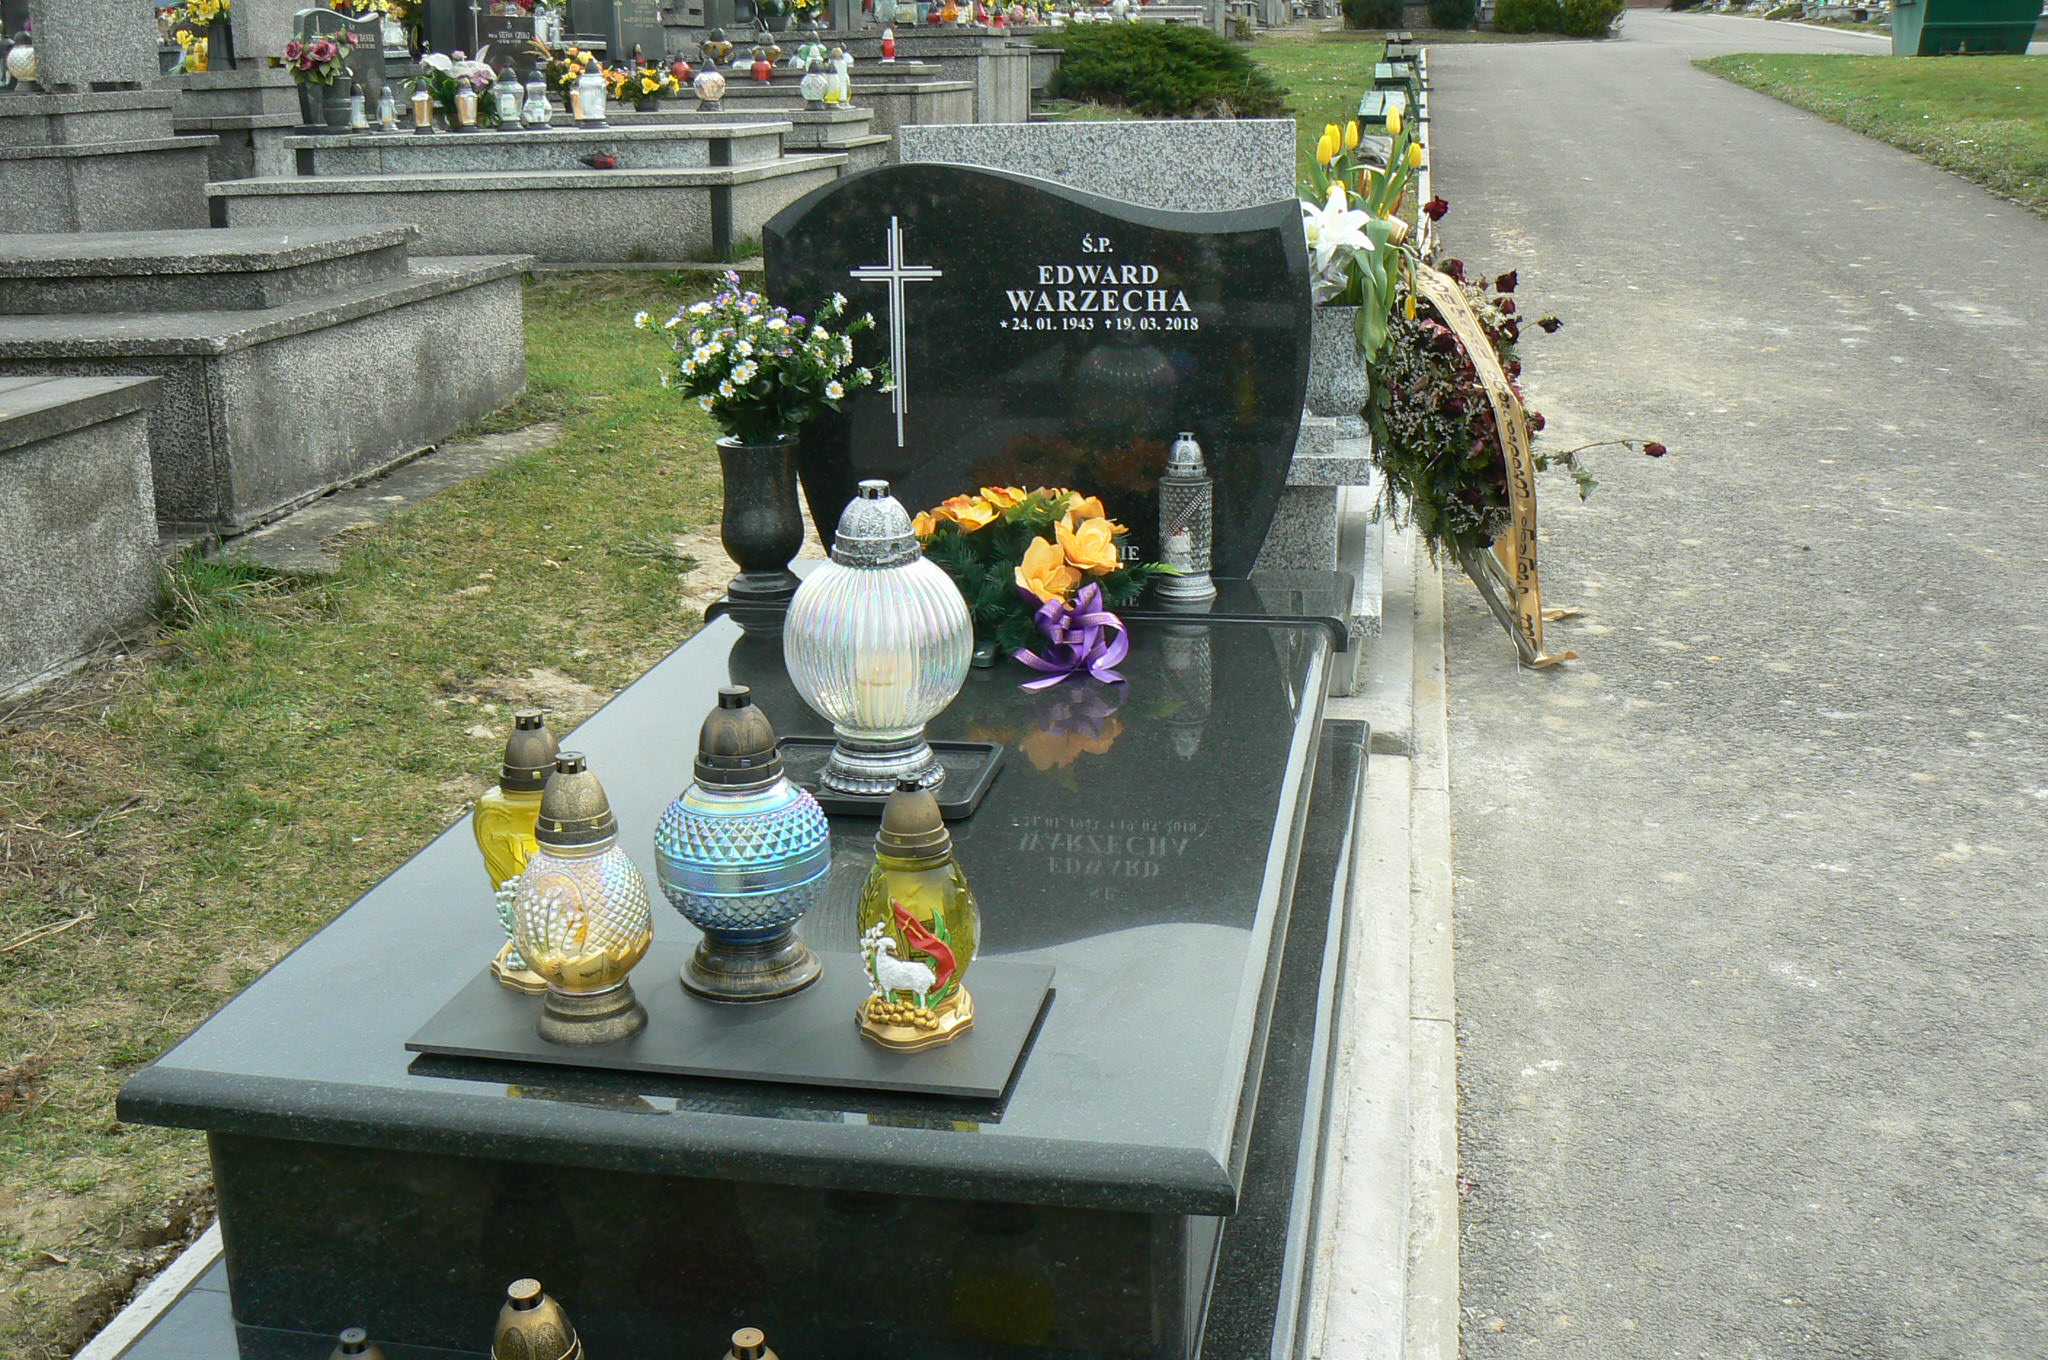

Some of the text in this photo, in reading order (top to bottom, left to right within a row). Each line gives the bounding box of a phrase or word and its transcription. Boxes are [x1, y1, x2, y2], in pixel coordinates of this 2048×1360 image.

[1082, 233, 1113, 253] Ś.P.
[1038, 265, 1159, 285] EDWARD
[1006, 290, 1192, 312] WARZECHA
